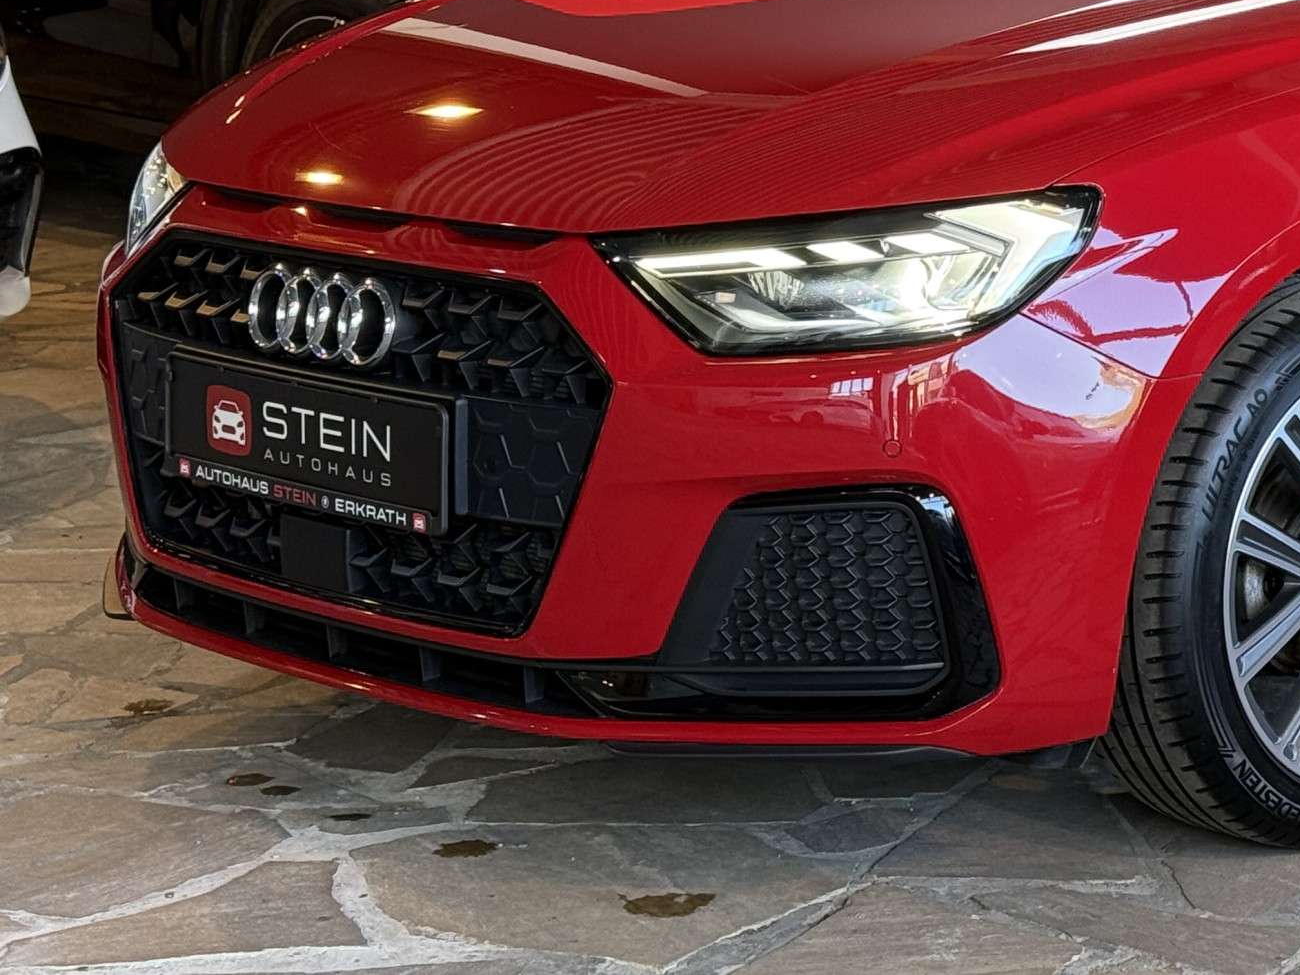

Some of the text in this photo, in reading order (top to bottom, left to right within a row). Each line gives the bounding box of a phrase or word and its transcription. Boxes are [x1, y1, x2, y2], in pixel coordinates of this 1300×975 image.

[262, 401, 391, 462] STEIN
[195, 465, 407, 525] AUTOHAUS STEIN ERKRATH
[263, 448, 392, 487] AUTOHAUS
[1202, 418, 1248, 522] ULTRAC
